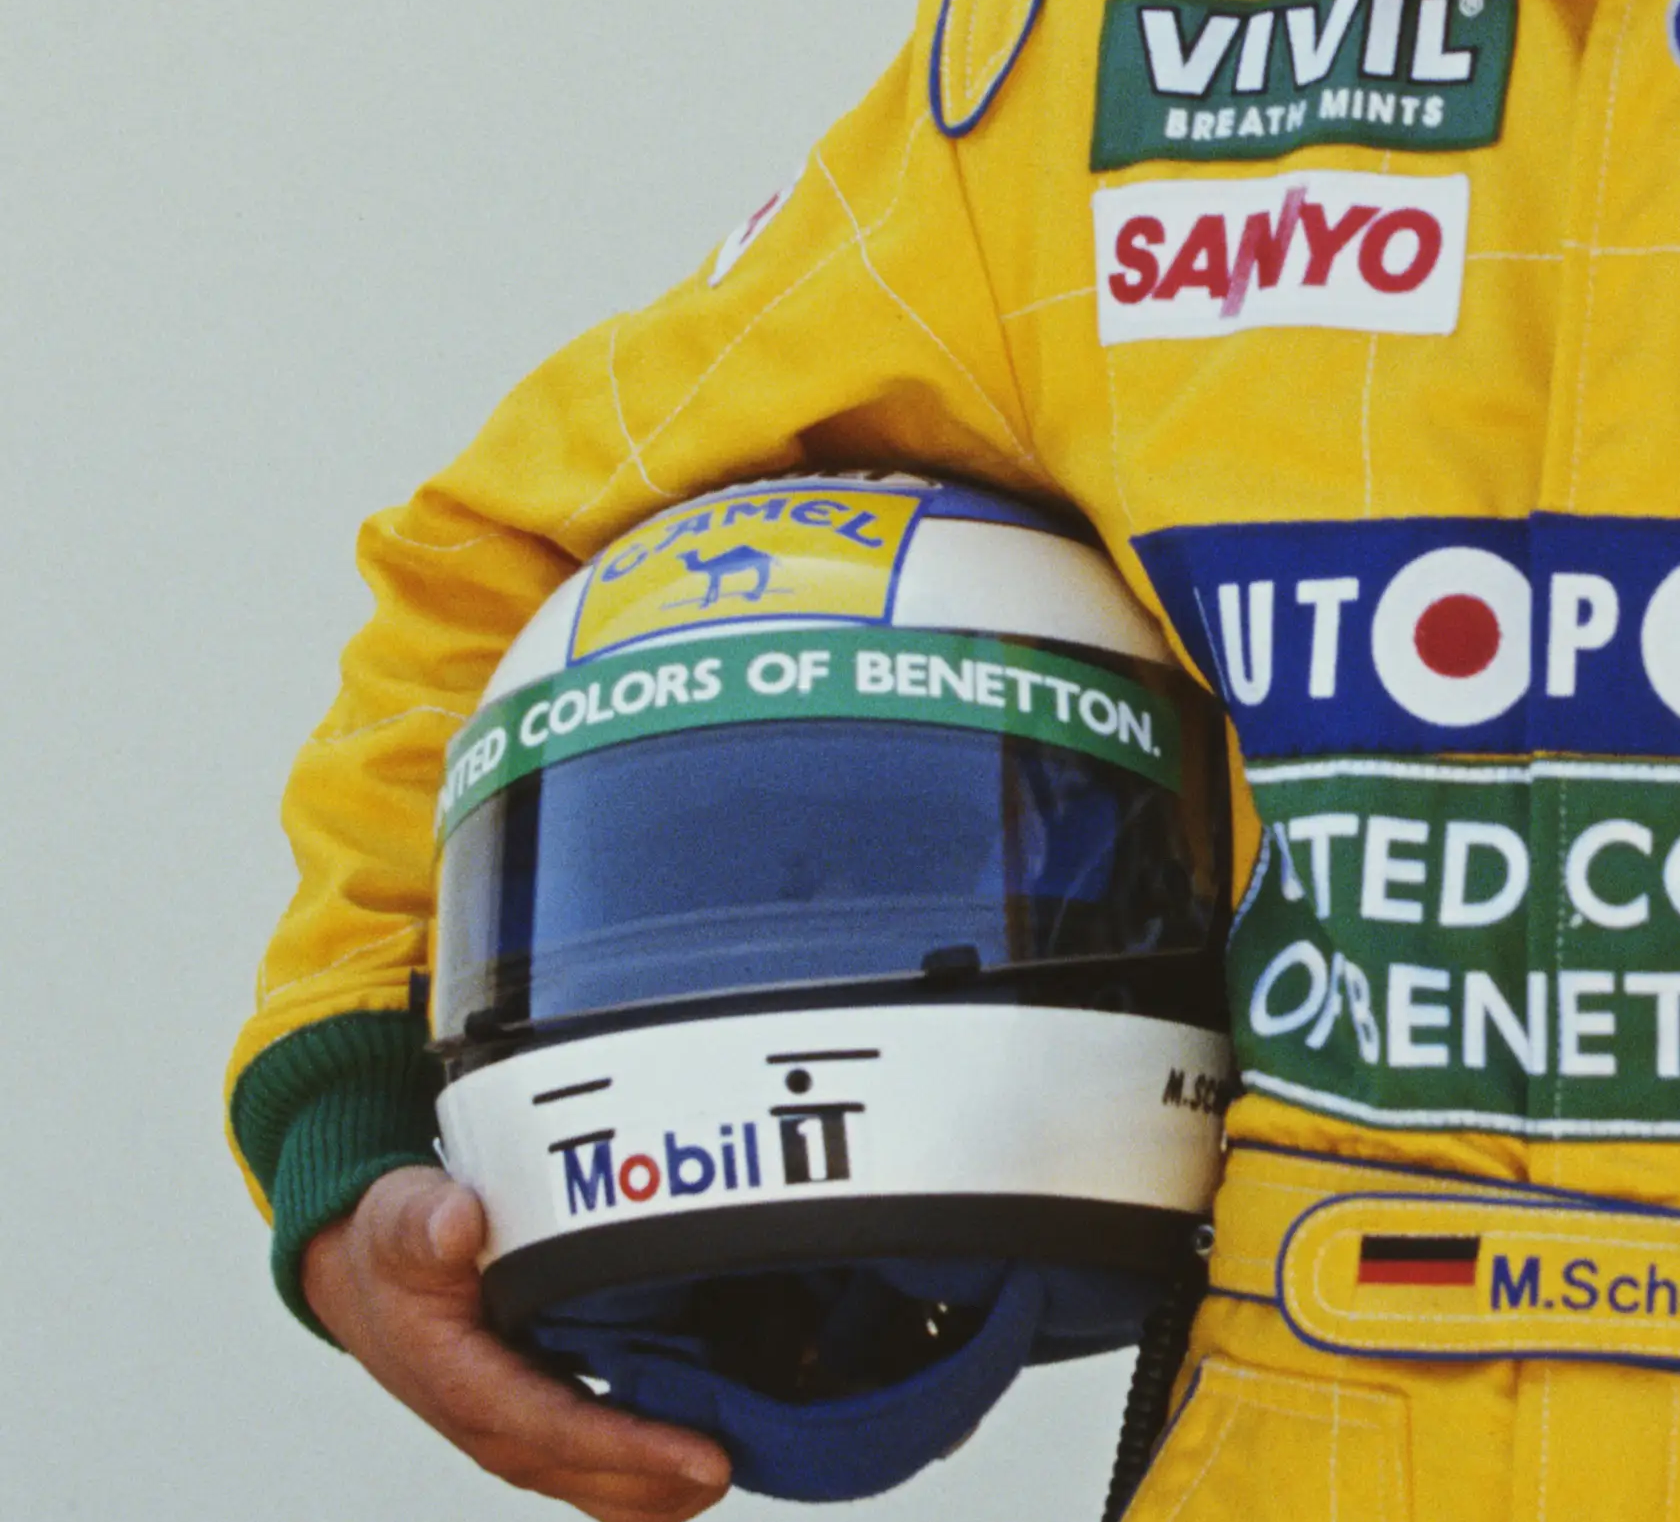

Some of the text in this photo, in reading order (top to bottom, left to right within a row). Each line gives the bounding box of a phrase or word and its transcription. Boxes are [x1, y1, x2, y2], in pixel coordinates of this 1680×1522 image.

[1164, 88, 1445, 141] BREATH MINTS
[1108, 186, 1443, 318] SANYO
[600, 497, 885, 582] CAMEL
[519, 657, 723, 748] COLORS
[746, 650, 831, 695] OF
[855, 650, 1162, 758] BENETTON.
[563, 1122, 762, 1216] Mobil
